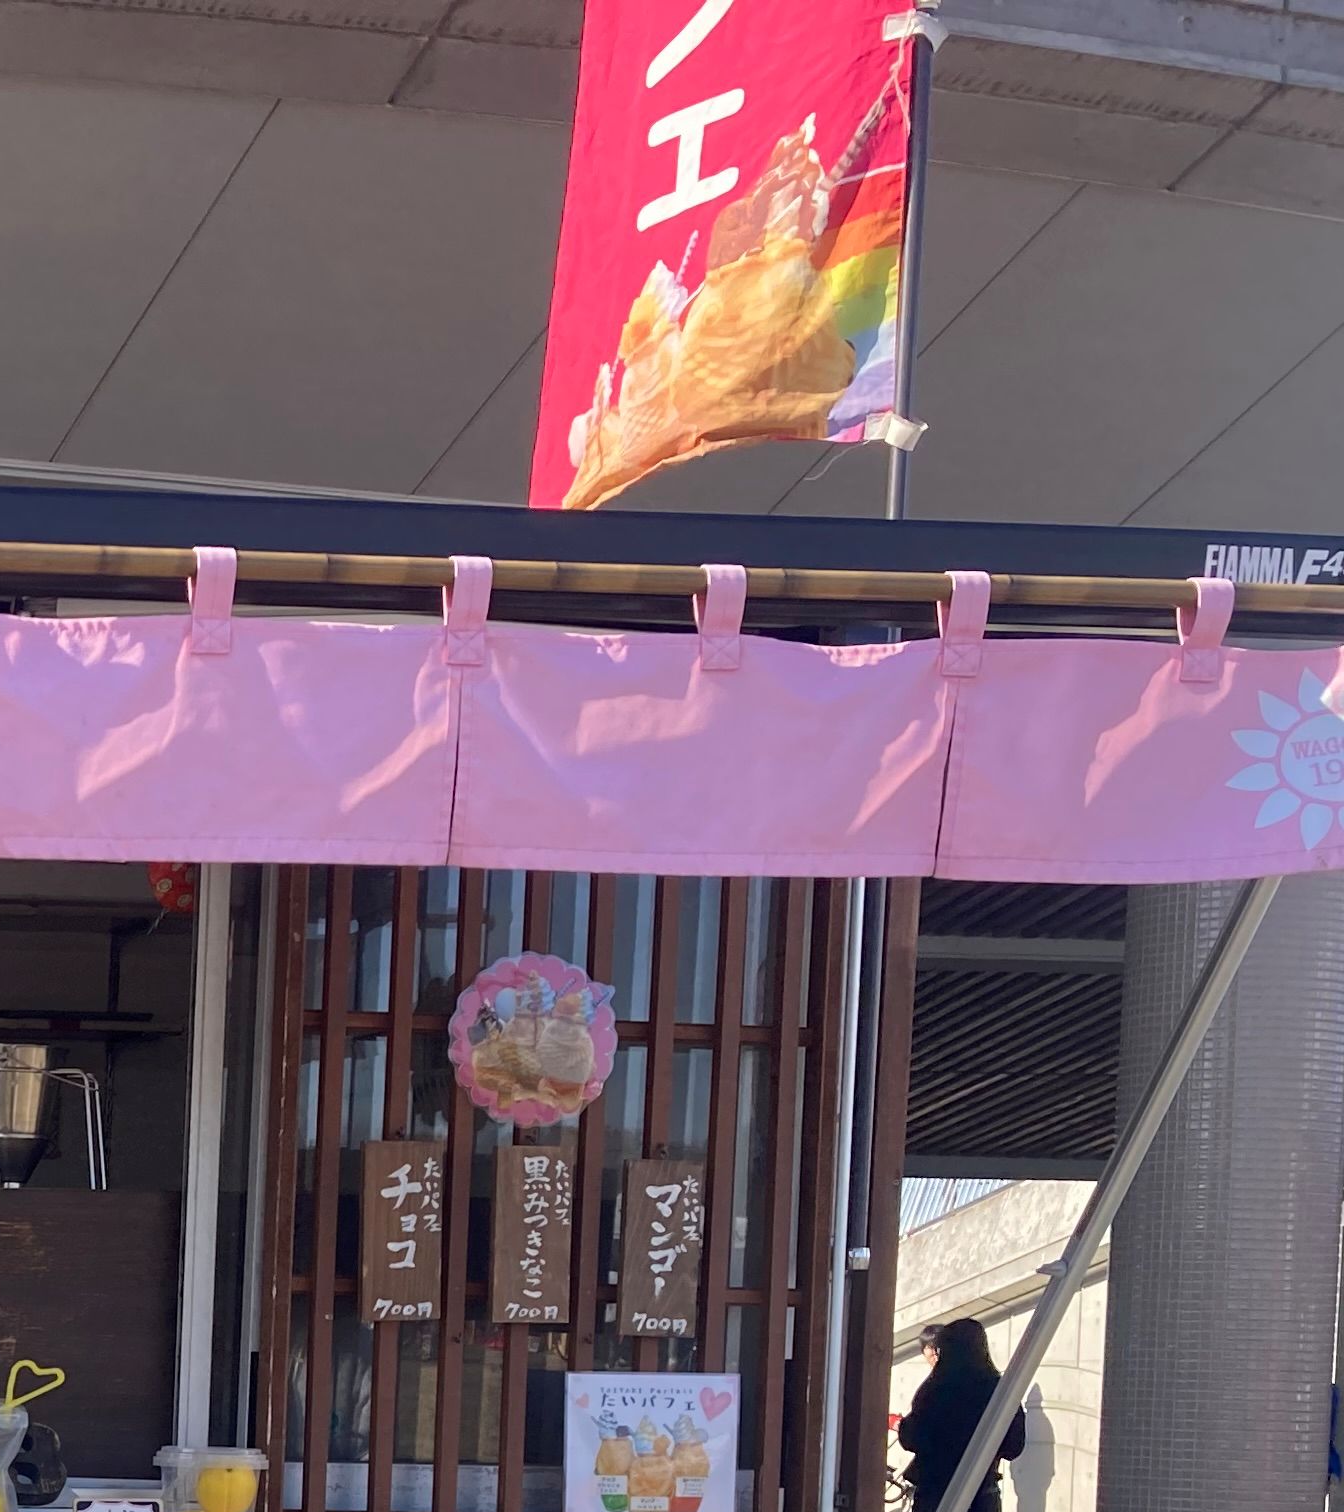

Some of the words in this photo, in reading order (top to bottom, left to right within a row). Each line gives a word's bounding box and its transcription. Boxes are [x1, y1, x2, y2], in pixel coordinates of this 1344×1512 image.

[1204, 544, 1295, 585] FIAMMA
[380, 1163, 422, 1269] チョコ
[420, 1156, 443, 1233] たいパフェ
[554, 1160, 572, 1226] たいパフェ
[682, 1174, 700, 1241] たいパフェ
[519, 1155, 552, 1299] 黒みつきなこ
[645, 1183, 688, 1301] マンゴー
[373, 1298, 433, 1319] 700円
[504, 1302, 559, 1320] 700円
[632, 1312, 688, 1336] 700円
[600, 1394, 696, 1412] たいパフェ
